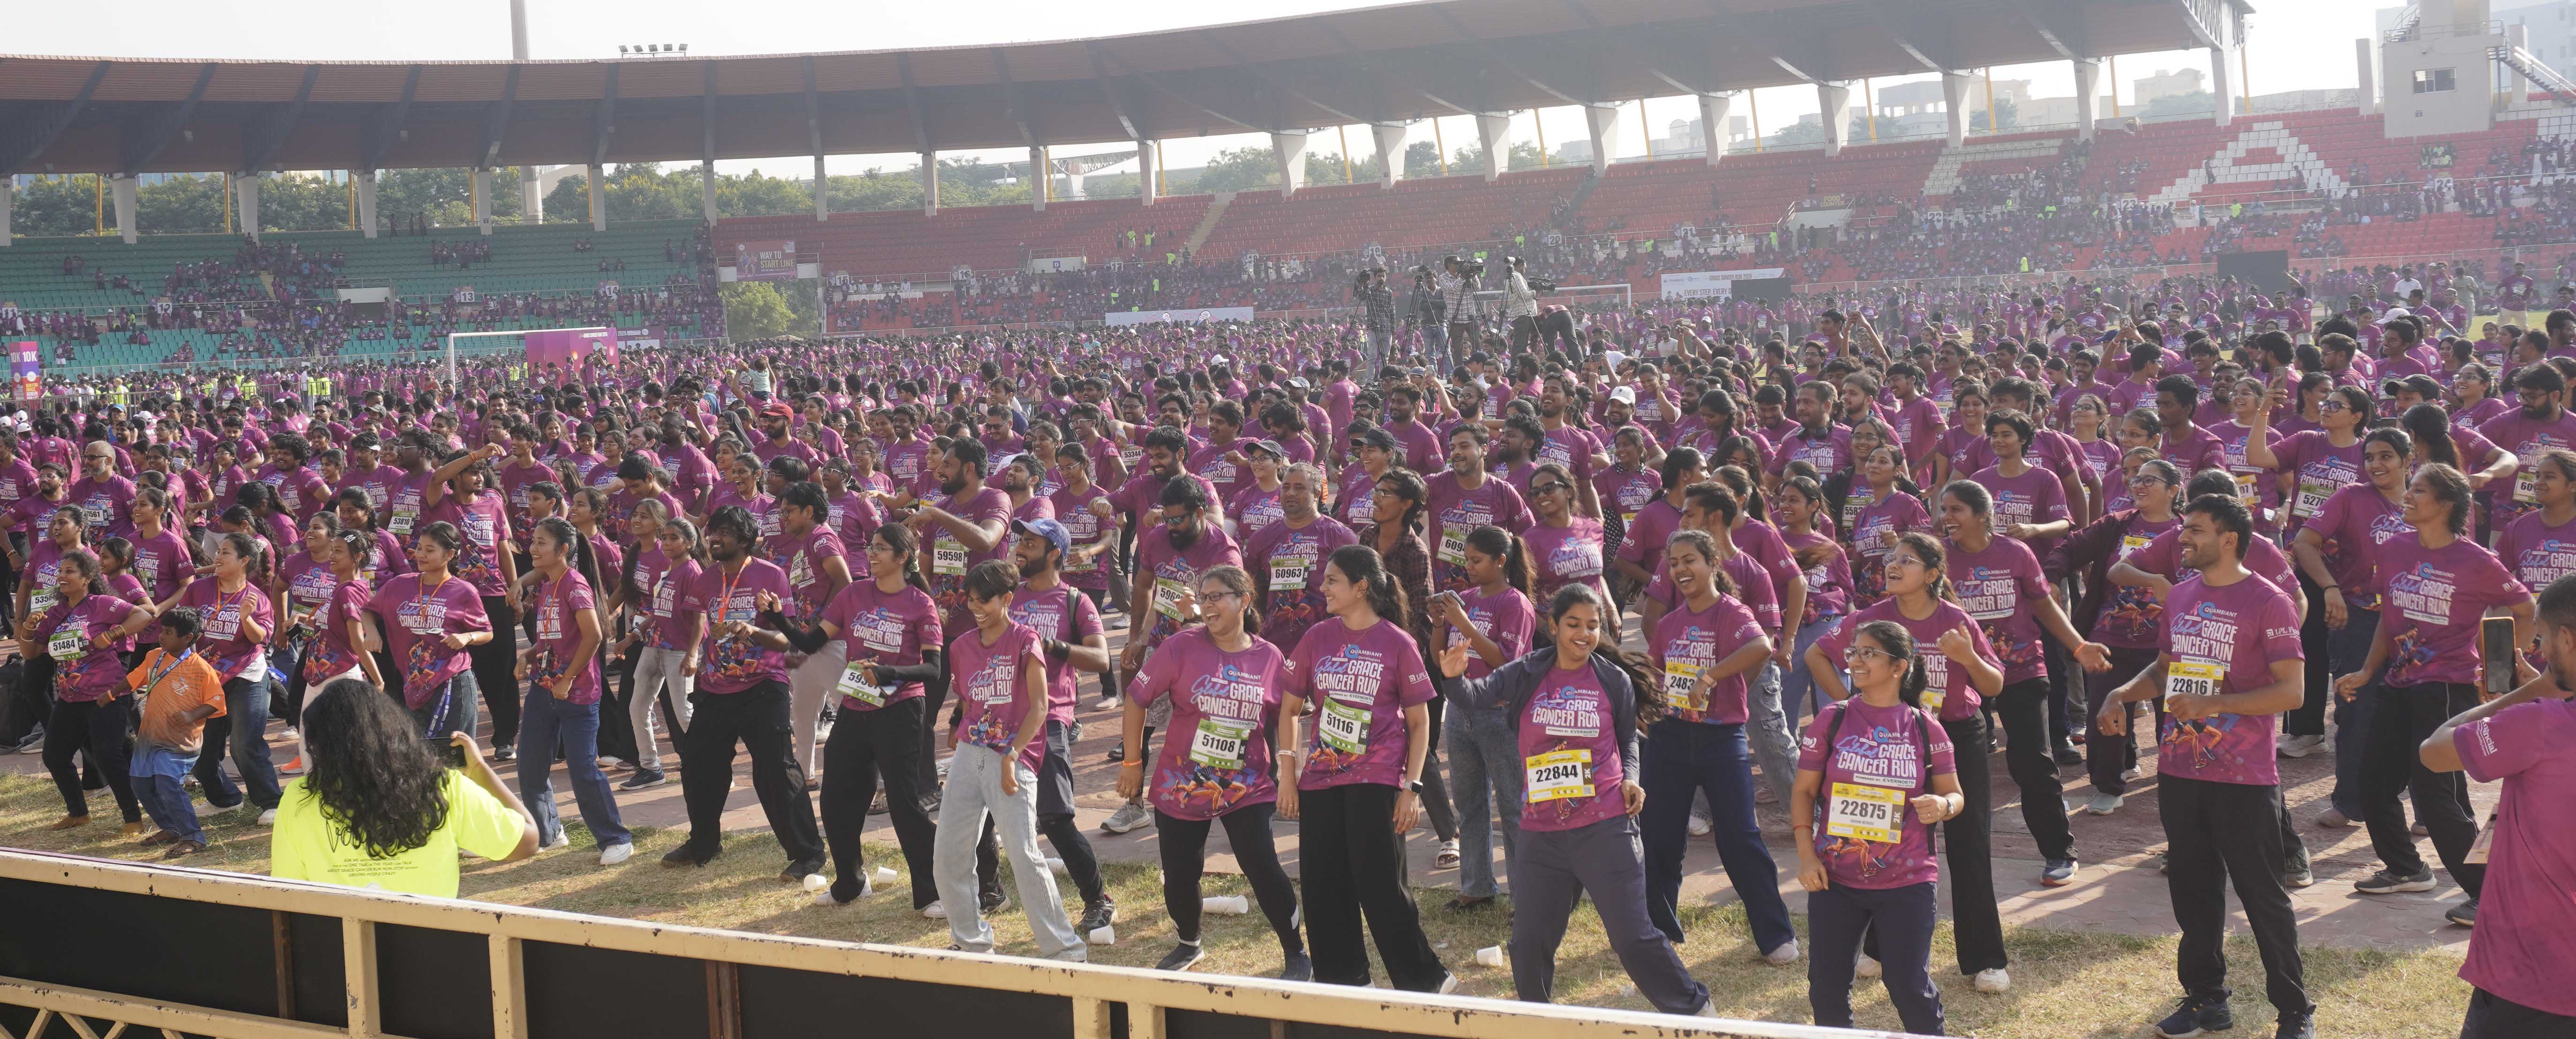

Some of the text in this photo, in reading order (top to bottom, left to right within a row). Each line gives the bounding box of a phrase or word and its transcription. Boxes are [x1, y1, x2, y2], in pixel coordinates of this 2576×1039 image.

[1550, 235, 1561, 245] 20
[760, 251, 773, 260] WAY
[760, 260, 779, 268] START
[462, 292, 473, 301] 13
[10, 352, 21, 362] 10K
[23, 351, 37, 362] 10K
[1549, 448, 1571, 459] GRACE
[1811, 448, 1834, 458] GRACE
[1818, 458, 1834, 467] RUN
[2328, 467, 2358, 483] GRACE
[2005, 503, 2033, 516] GRACE
[474, 520, 494, 530] GRACE
[830, 518, 842, 526] RUN
[1467, 512, 1493, 526] GRACE
[1085, 524, 1098, 532] RUN
[1294, 542, 1318, 555] GRACE
[938, 551, 962, 562] 59598
[139, 558, 159, 569] GRACE
[1555, 557, 1589, 576] CANCER
[1276, 568, 1302, 579] 60963
[292, 585, 319, 598] CANCER
[1984, 580, 2015, 594] GRACE
[2419, 580, 2456, 602] GRACE
[660, 599, 673, 611] RUN
[729, 596, 755, 609] GRACE
[1997, 594, 2015, 609] RUN
[2393, 590, 2452, 617] CANCER RUN
[2205, 607, 2237, 617] QUAMBIANT
[427, 615, 445, 629] RUN
[1028, 613, 1061, 627] GRACE
[224, 621, 239, 634] RUN
[878, 620, 906, 634] GRACE
[2202, 620, 2238, 644] GRACE
[853, 624, 902, 646] CANCER RUN
[53, 639, 76, 651] 51484
[2172, 634, 2209, 656] CANCER
[1350, 648, 1382, 657] QUAMBIANT
[1228, 670, 1261, 680] QUAMBIANT
[1314, 655, 1347, 683] Global
[1347, 661, 1384, 679] GRACE
[1317, 672, 1380, 696] CANCER RUN
[1925, 671, 1948, 687] RUN
[1191, 675, 1265, 704] Global GRACE
[2173, 678, 2208, 695] 22816
[1197, 695, 1263, 721] CANCER RUN
[1327, 713, 1353, 734] 51116
[1532, 708, 1600, 727] CANCER RUN
[1361, 729, 1366, 739] 5K
[1202, 734, 1235, 753] 51108
[1836, 735, 1879, 758] Global
[1879, 744, 1917, 760] GRACE
[1838, 751, 1917, 777] CANCER RUN
[1536, 765, 1578, 783] 22844
[1584, 768, 1591, 779] 2K
[1840, 800, 1886, 820] 22875
[1894, 813, 1901, 823] 2K
